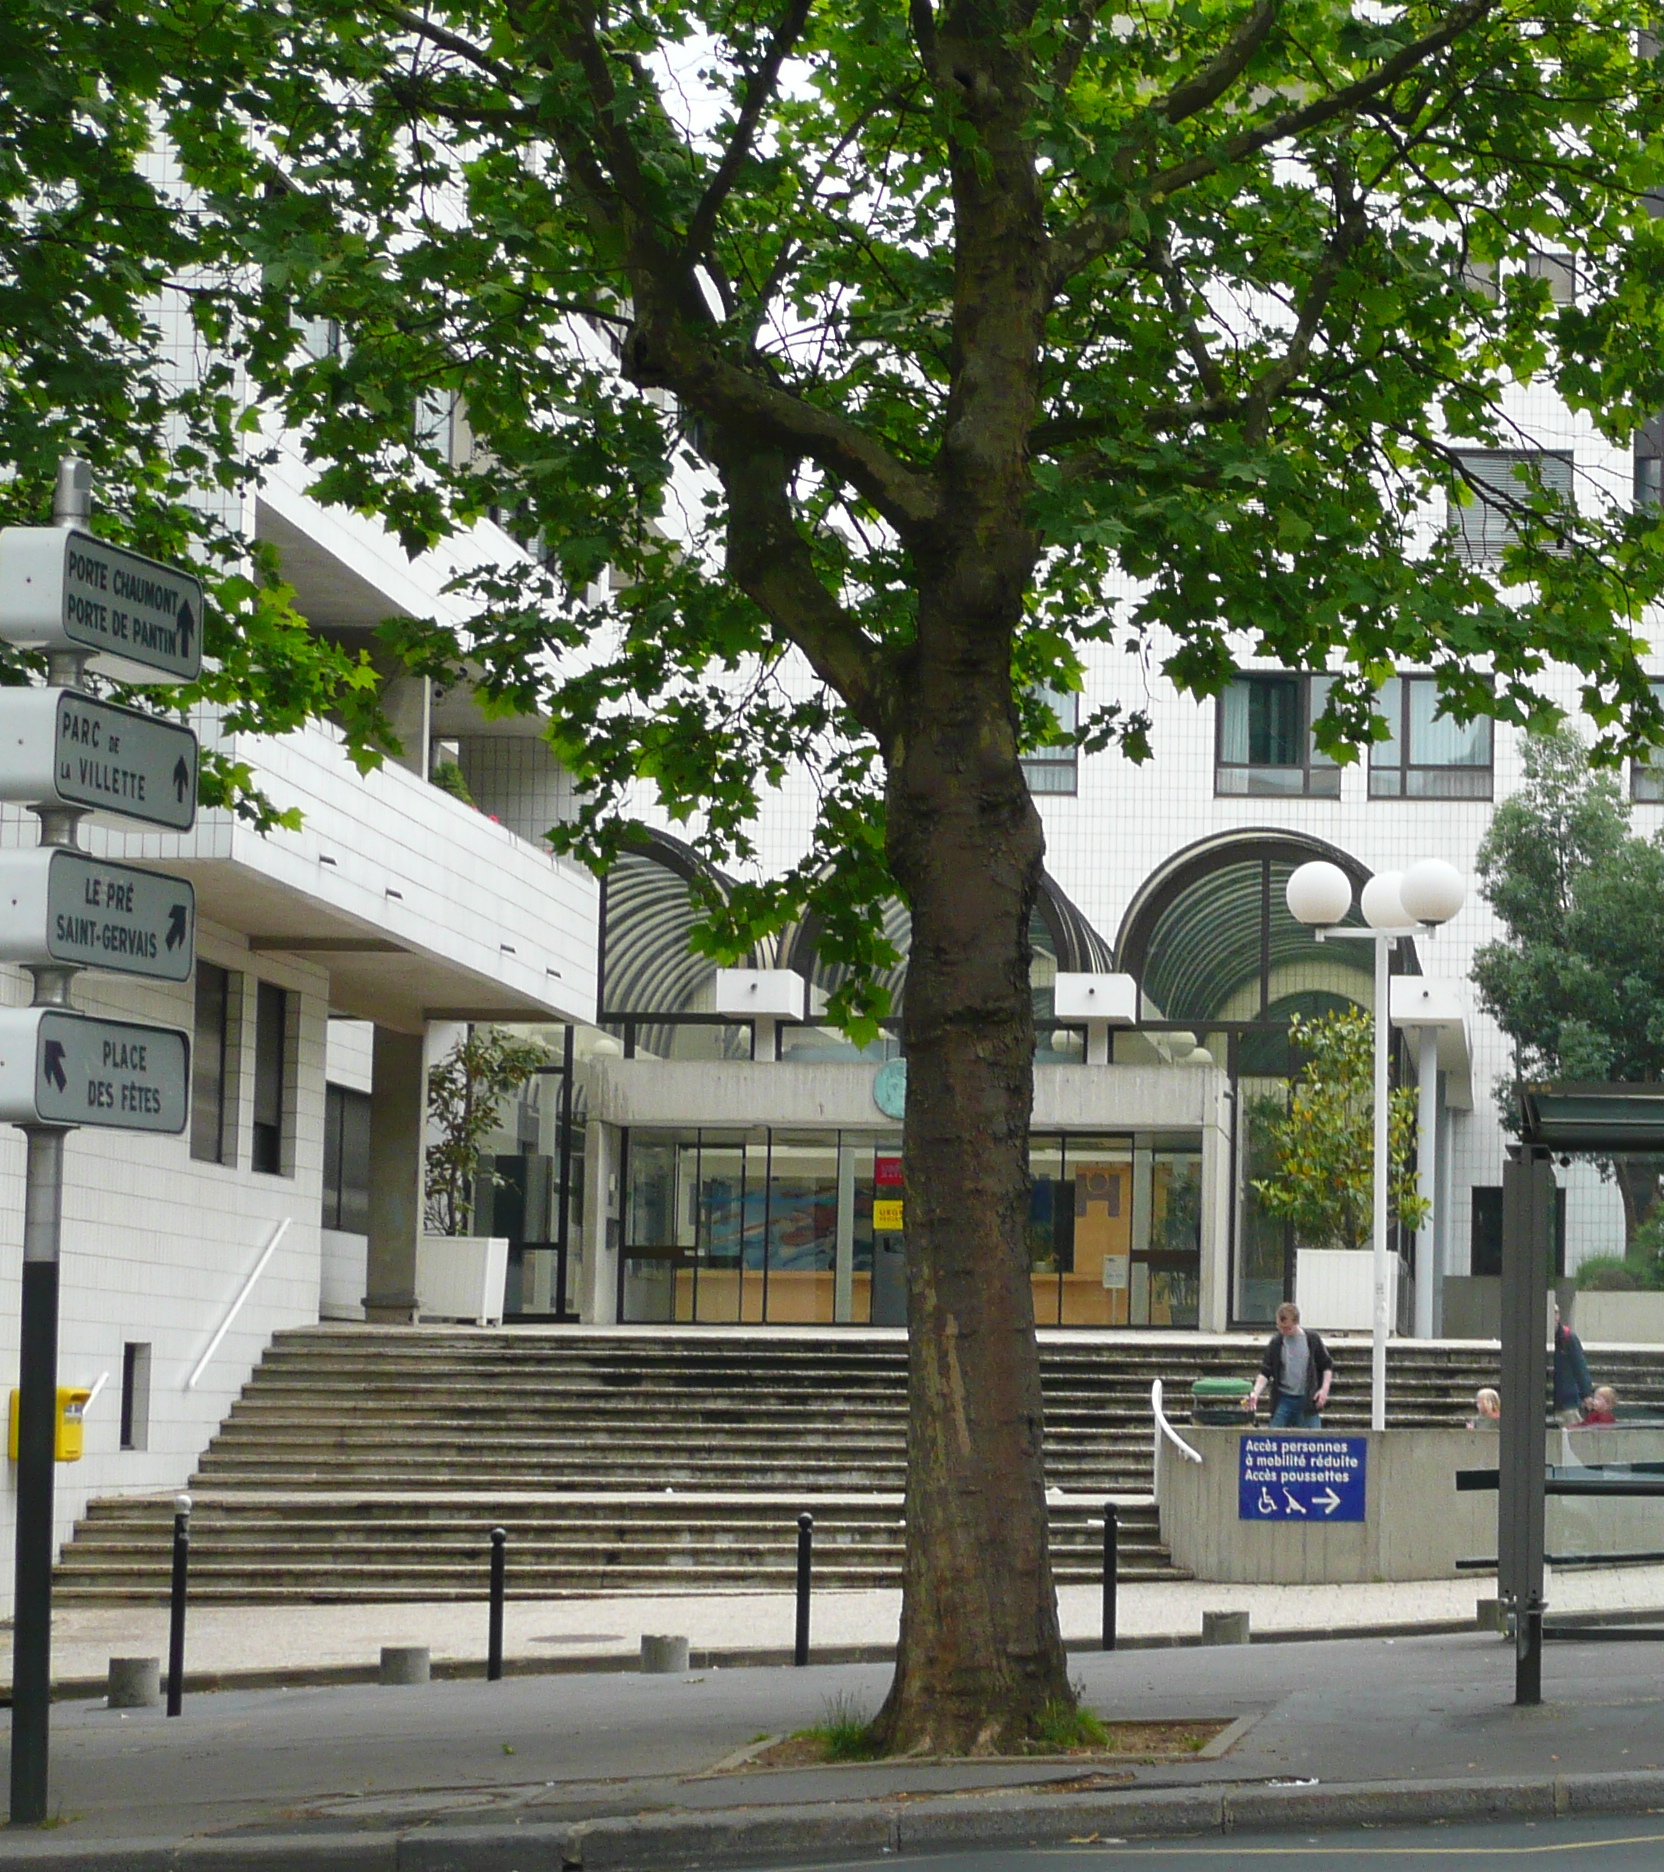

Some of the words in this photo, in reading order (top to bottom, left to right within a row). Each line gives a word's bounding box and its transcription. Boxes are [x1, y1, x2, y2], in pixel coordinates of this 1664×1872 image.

[68, 550, 108, 591] PORTE
[113, 569, 179, 616] CHAUMONT
[67, 593, 107, 633] PORTE
[111, 609, 128, 640] DE
[133, 617, 178, 656] PANTIN
[62, 711, 100, 748] PARC
[109, 734, 120, 754] DE
[61, 761, 71, 780] LA
[79, 756, 146, 802] VILLETTE
[85, 878, 101, 906] LE
[106, 882, 134, 913] PRÉ
[56, 914, 158, 959] SAINT-GERVAIS
[103, 1040, 147, 1072] PLACE
[88, 1080, 114, 1108] DES
[121, 1081, 161, 1115] FÊTES
[1245, 1439, 1278, 1452] Accès
[1281, 1442, 1348, 1456] personnes
[1245, 1453, 1253, 1466] à
[1256, 1454, 1306, 1467] mobilité
[1310, 1454, 1358, 1468] réduite
[1244, 1468, 1277, 1481] Accès
[1281, 1471, 1349, 1484] poussettes
